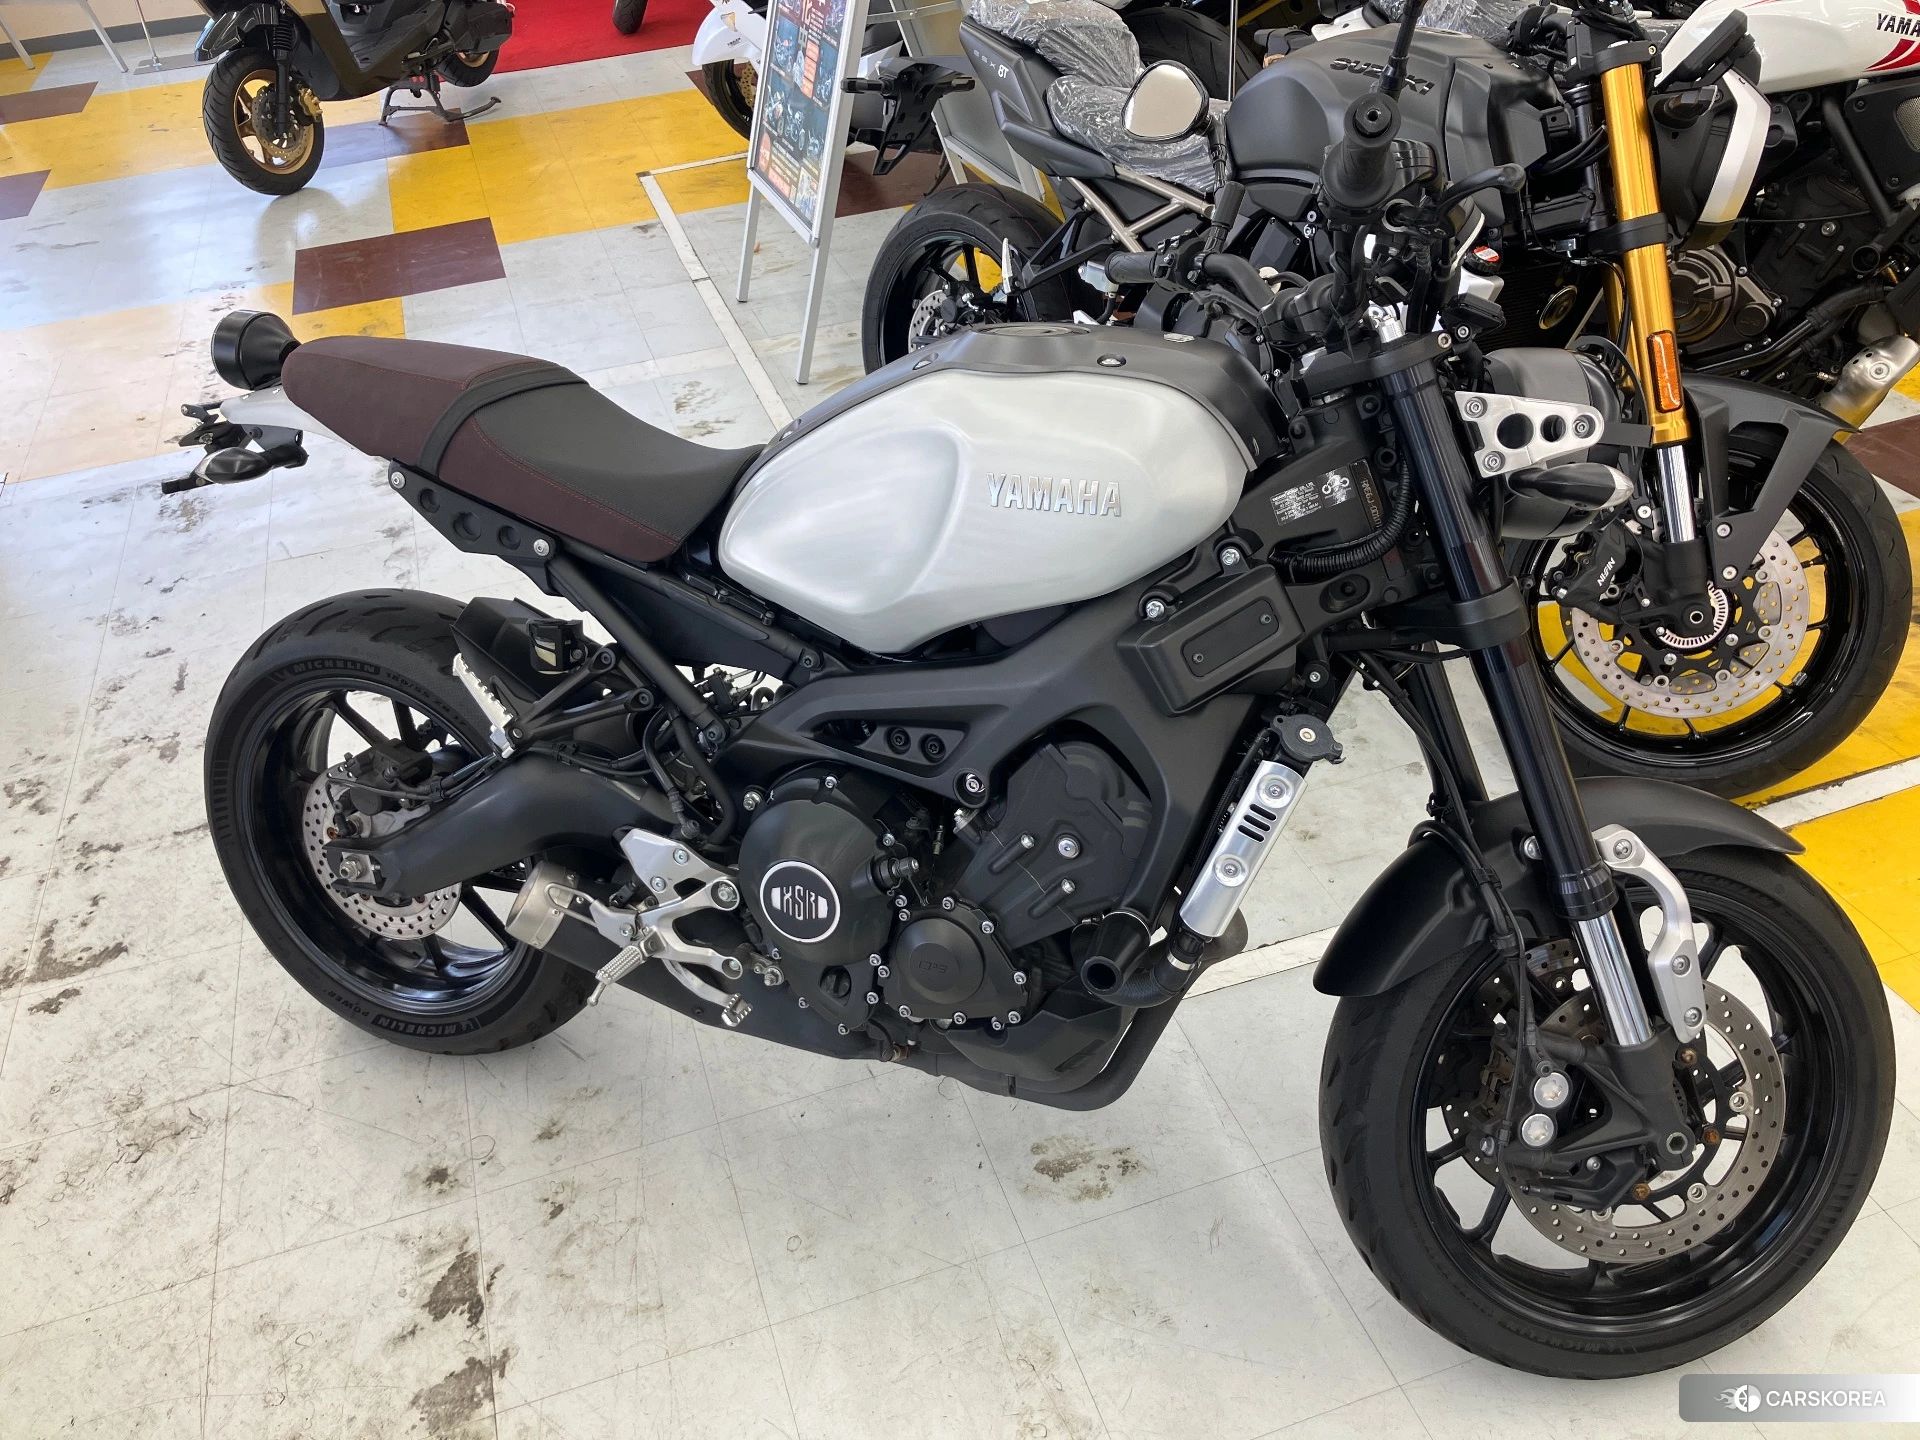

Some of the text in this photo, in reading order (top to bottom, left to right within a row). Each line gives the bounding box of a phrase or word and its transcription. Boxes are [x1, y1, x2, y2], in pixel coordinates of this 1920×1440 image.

[1330, 58, 1435, 96] SUZKI
[986, 472, 1122, 517] YAMAHA
[1597, 556, 1616, 587] NISSIN
[293, 659, 376, 674] MICHELIN
[783, 885, 816, 921] XSR
[378, 1016, 458, 1036] MICHELIN
